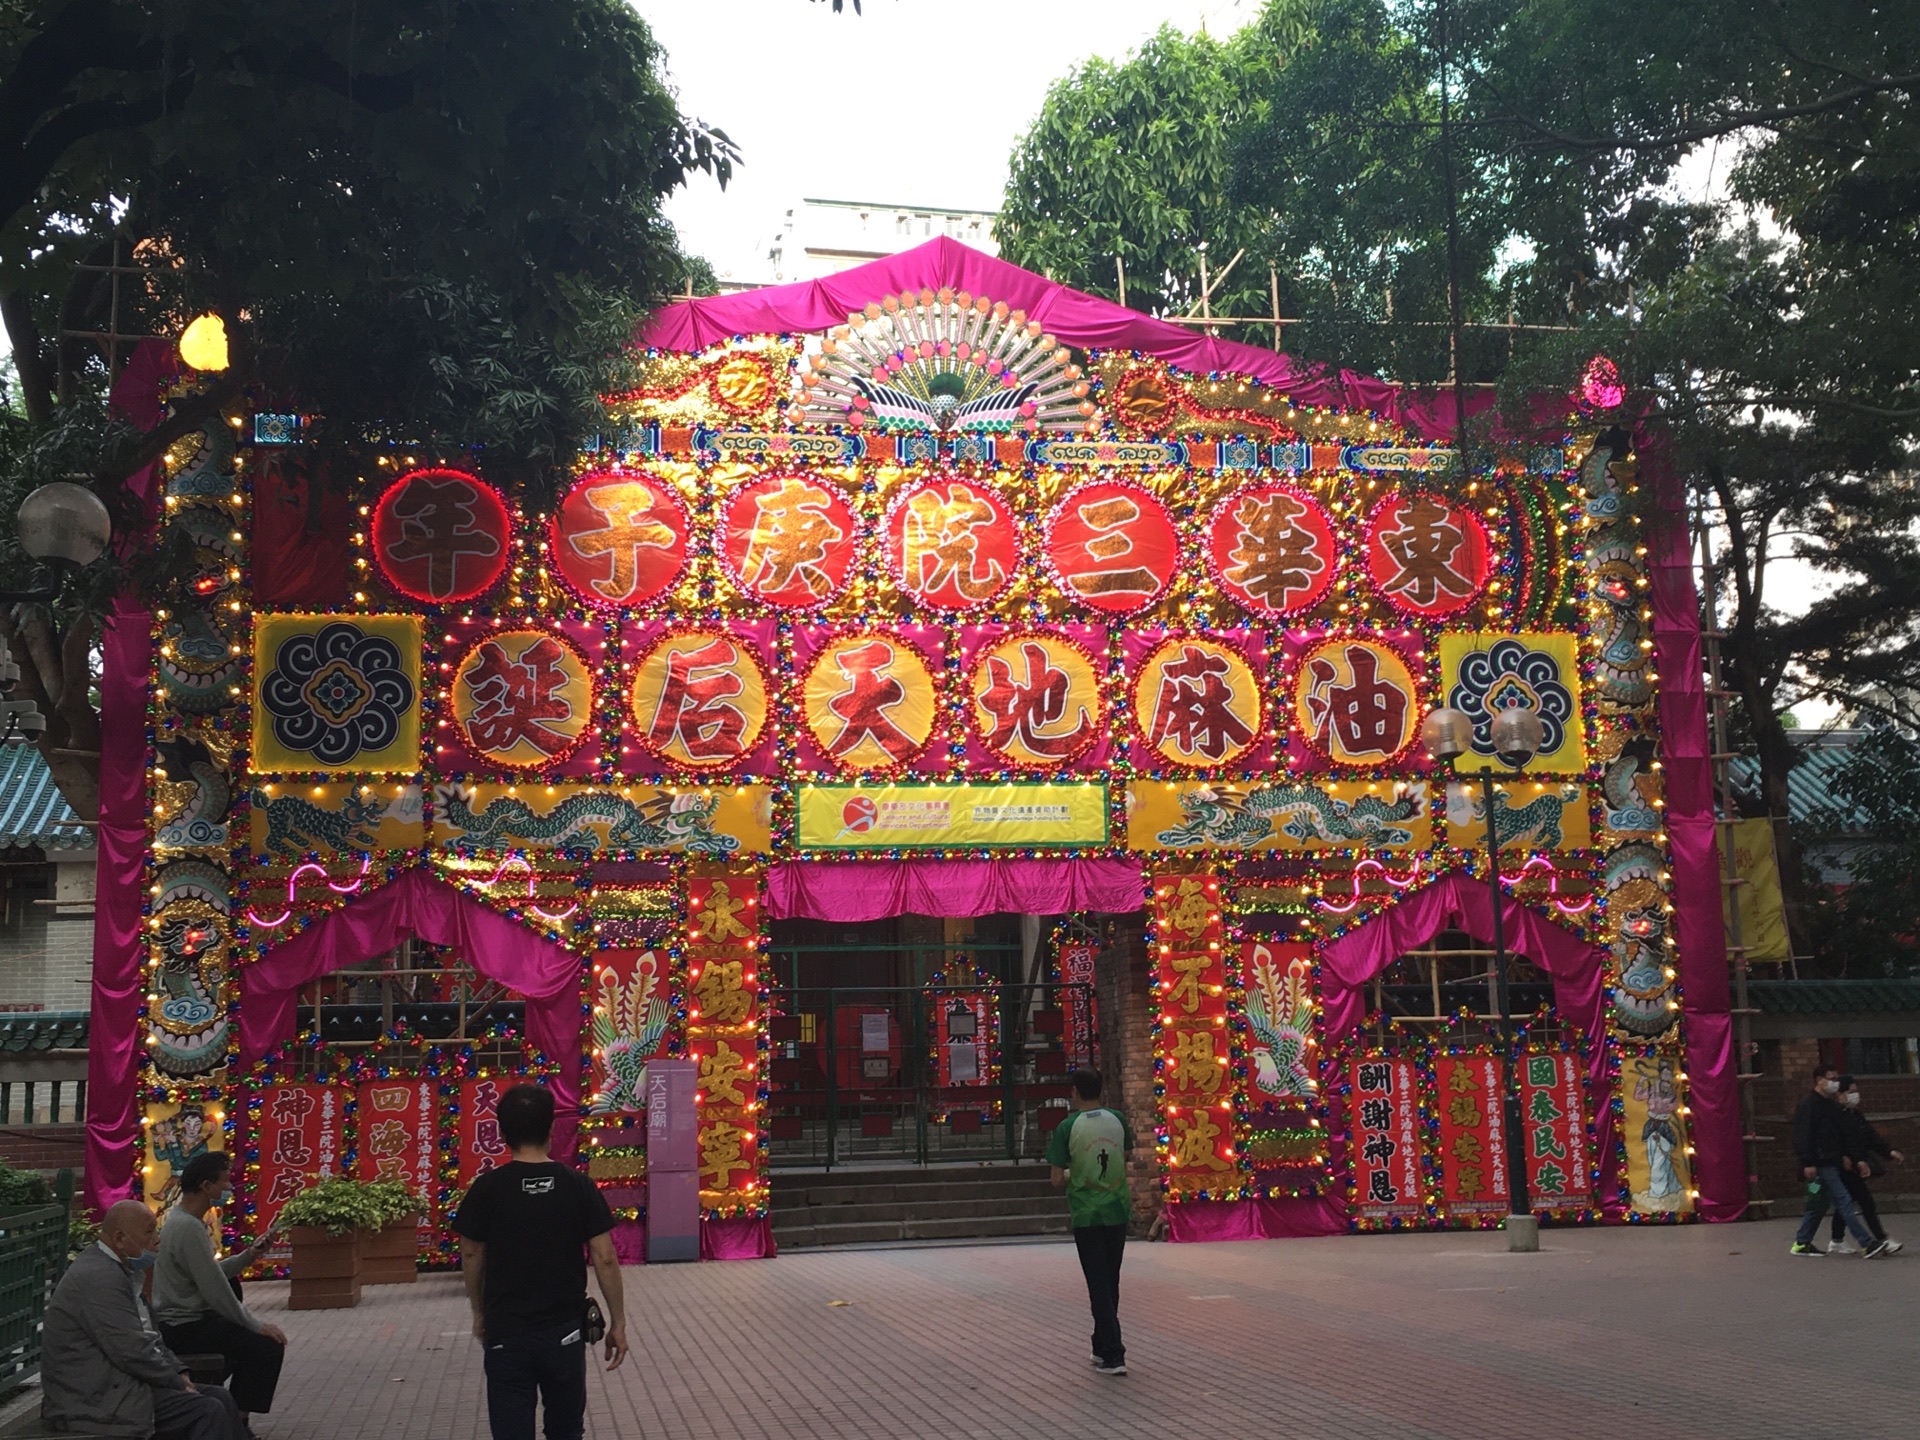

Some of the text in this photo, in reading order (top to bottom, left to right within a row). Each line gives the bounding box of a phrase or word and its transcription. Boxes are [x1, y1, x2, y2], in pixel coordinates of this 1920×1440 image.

[462, 637, 1408, 762] 油麻地天后誕
[882, 813, 906, 821] Leisure
[923, 812, 950, 820] Cultural
[909, 821, 950, 831] Department
[1158, 877, 1231, 1171] 海不揚波
[416, 1081, 433, 1229] 東華三院油麻地天誕
[649, 1074, 667, 1128] 天后廟
[1357, 1061, 1399, 1204] 酬謝神恩
[1397, 1064, 1418, 1198] 東華三院油麻地天后誕
[1483, 1061, 1507, 1195] 東華三院油麻地天后誕
[1526, 1055, 1569, 1195] 國泰民安
[1562, 1056, 1587, 1190] 東華三院油麻地天后誕
